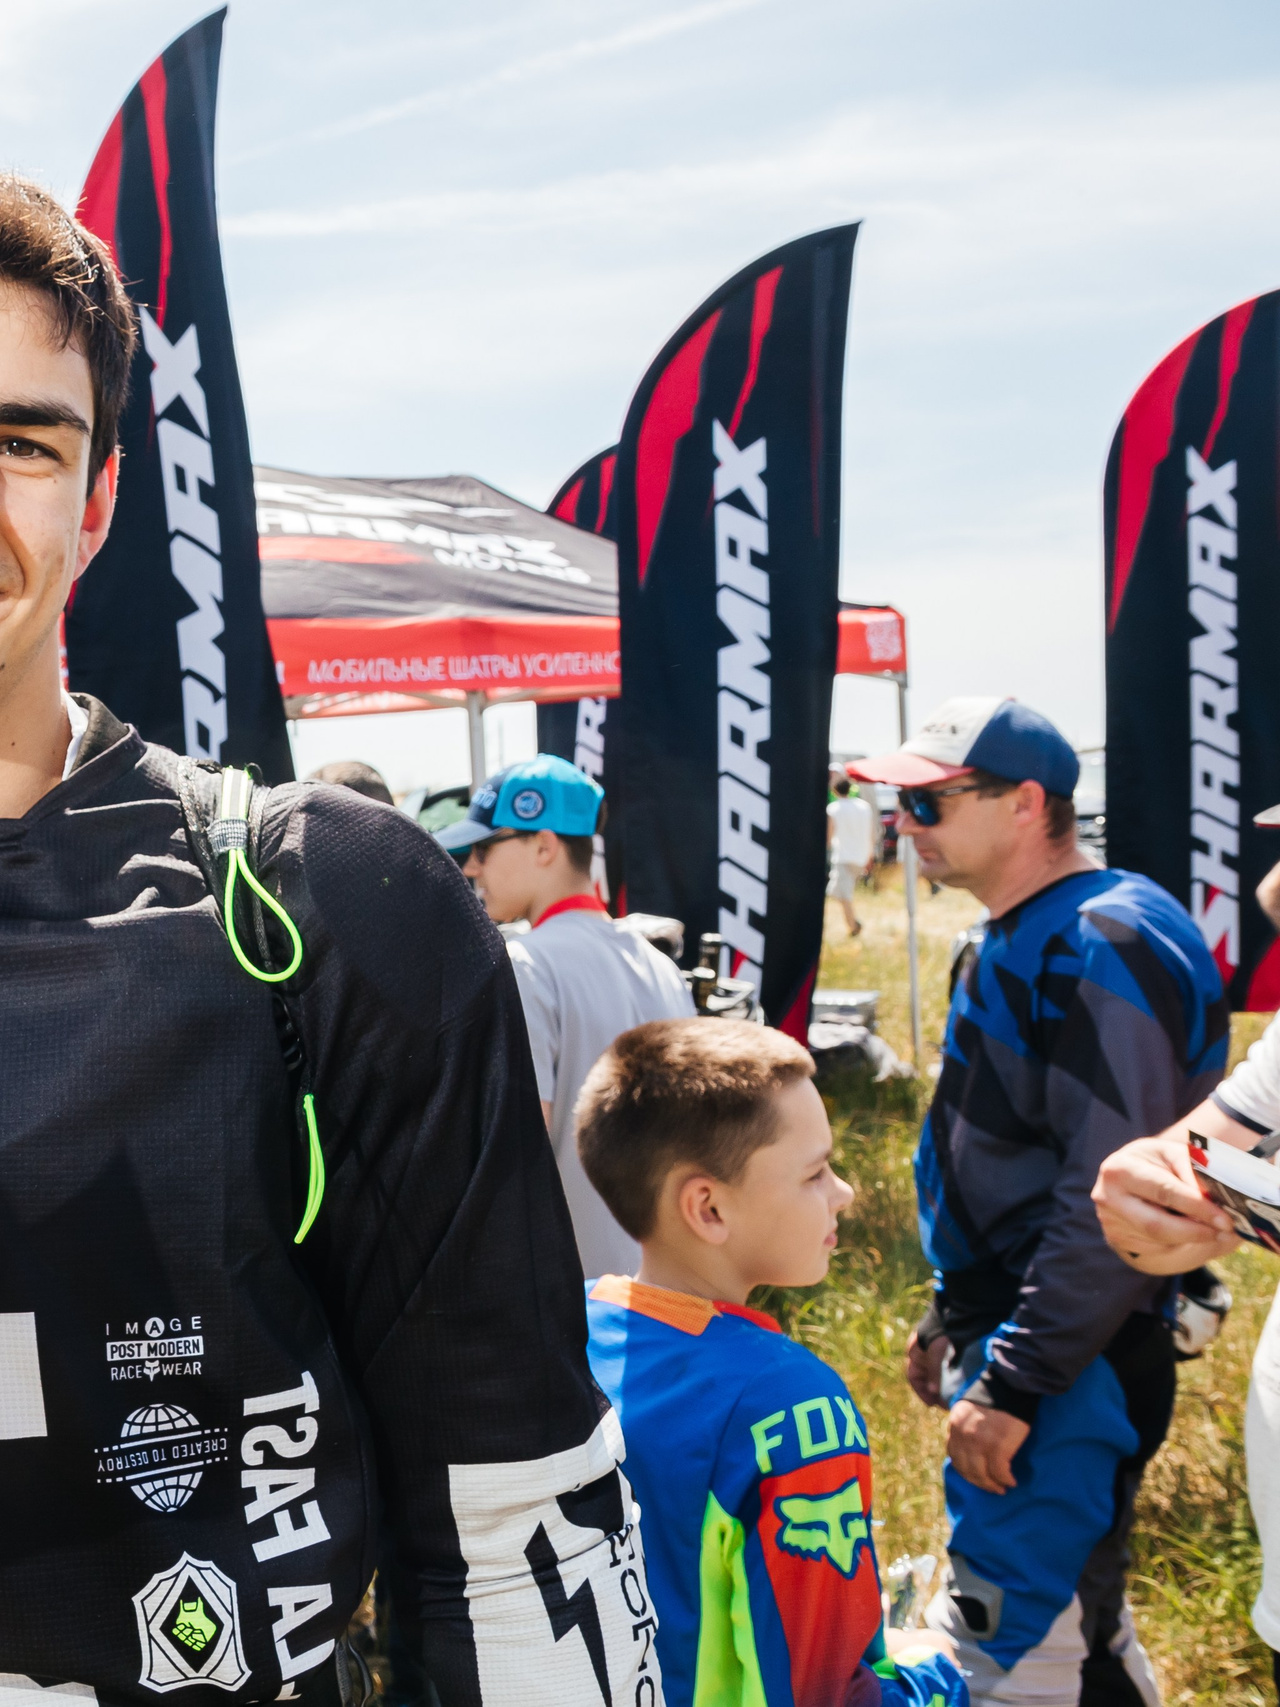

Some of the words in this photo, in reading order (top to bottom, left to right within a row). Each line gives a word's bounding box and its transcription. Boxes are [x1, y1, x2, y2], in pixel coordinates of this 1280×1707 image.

[307, 656, 446, 684] МОБИЛЬНЫЕ
[448, 653, 521, 681] ШАТРЫ
[1186, 445, 1240, 967] SHARMAX
[105, 1316, 202, 1338] IMAGE
[110, 1343, 143, 1359] POST
[146, 1339, 200, 1357] MODERN
[110, 1366, 143, 1381] RACE
[161, 1361, 202, 1376] WEAR
[750, 1396, 868, 1474] FOX
[152, 1448, 167, 1463] TO
[172, 1437, 227, 1459] CREATED
[97, 1450, 149, 1472] DESTROY
